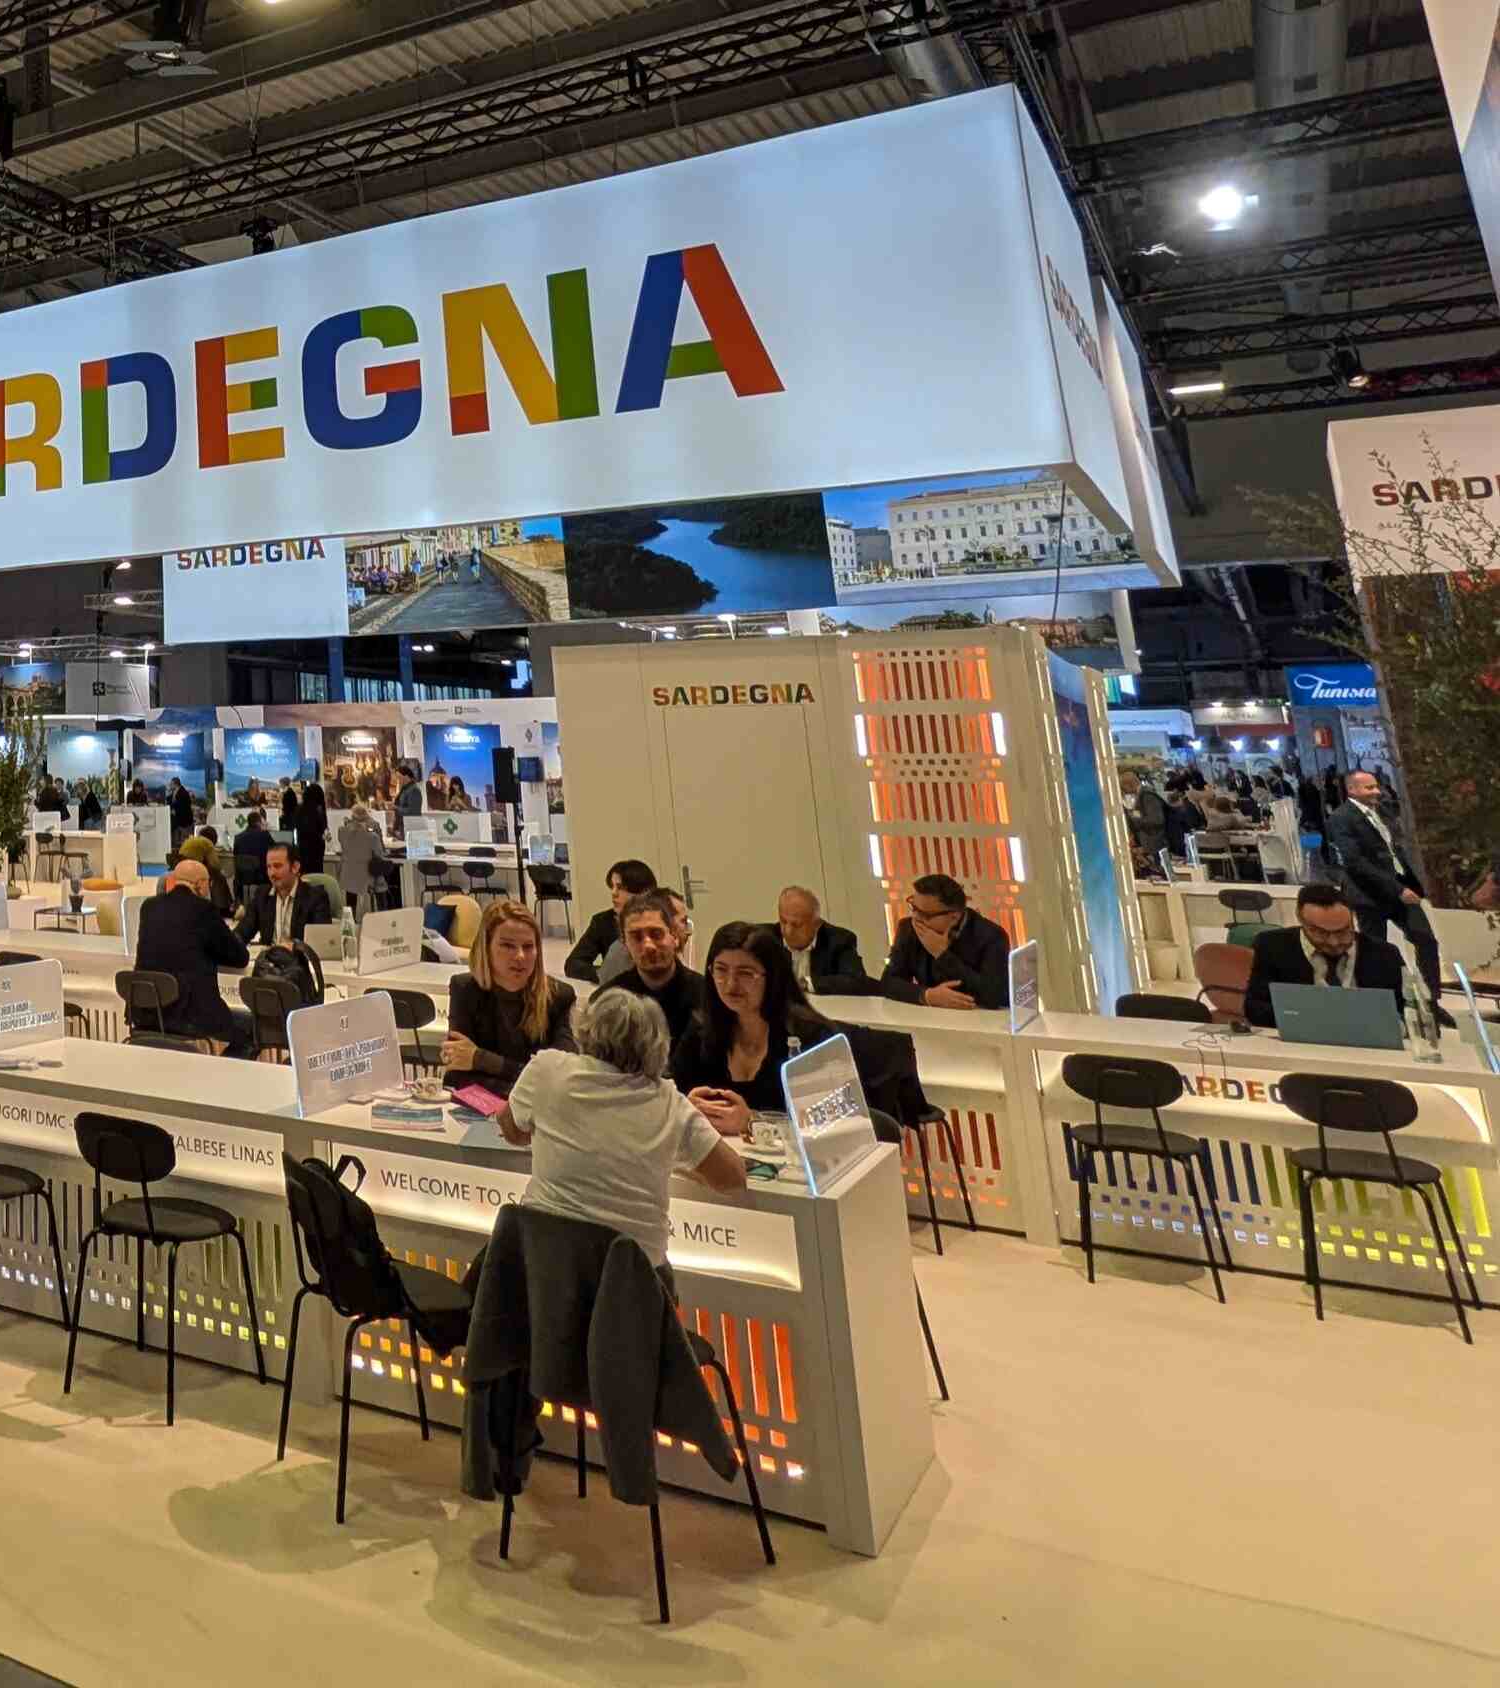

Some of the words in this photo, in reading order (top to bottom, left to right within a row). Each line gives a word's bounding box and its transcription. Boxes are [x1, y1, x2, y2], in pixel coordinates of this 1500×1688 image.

[1372, 474, 1500, 506] SARD
[176, 535, 326, 570] SARDEGNA
[652, 682, 816, 707] SARDEGNA
[1294, 673, 1377, 699] Tunisia
[36, 1109, 67, 1129] DMC
[176, 1136, 226, 1159] ALBESE
[231, 1144, 275, 1166] LINAS
[380, 1169, 471, 1201] WELCOME
[475, 1185, 502, 1207] TO
[683, 1221, 737, 1248] MICE
